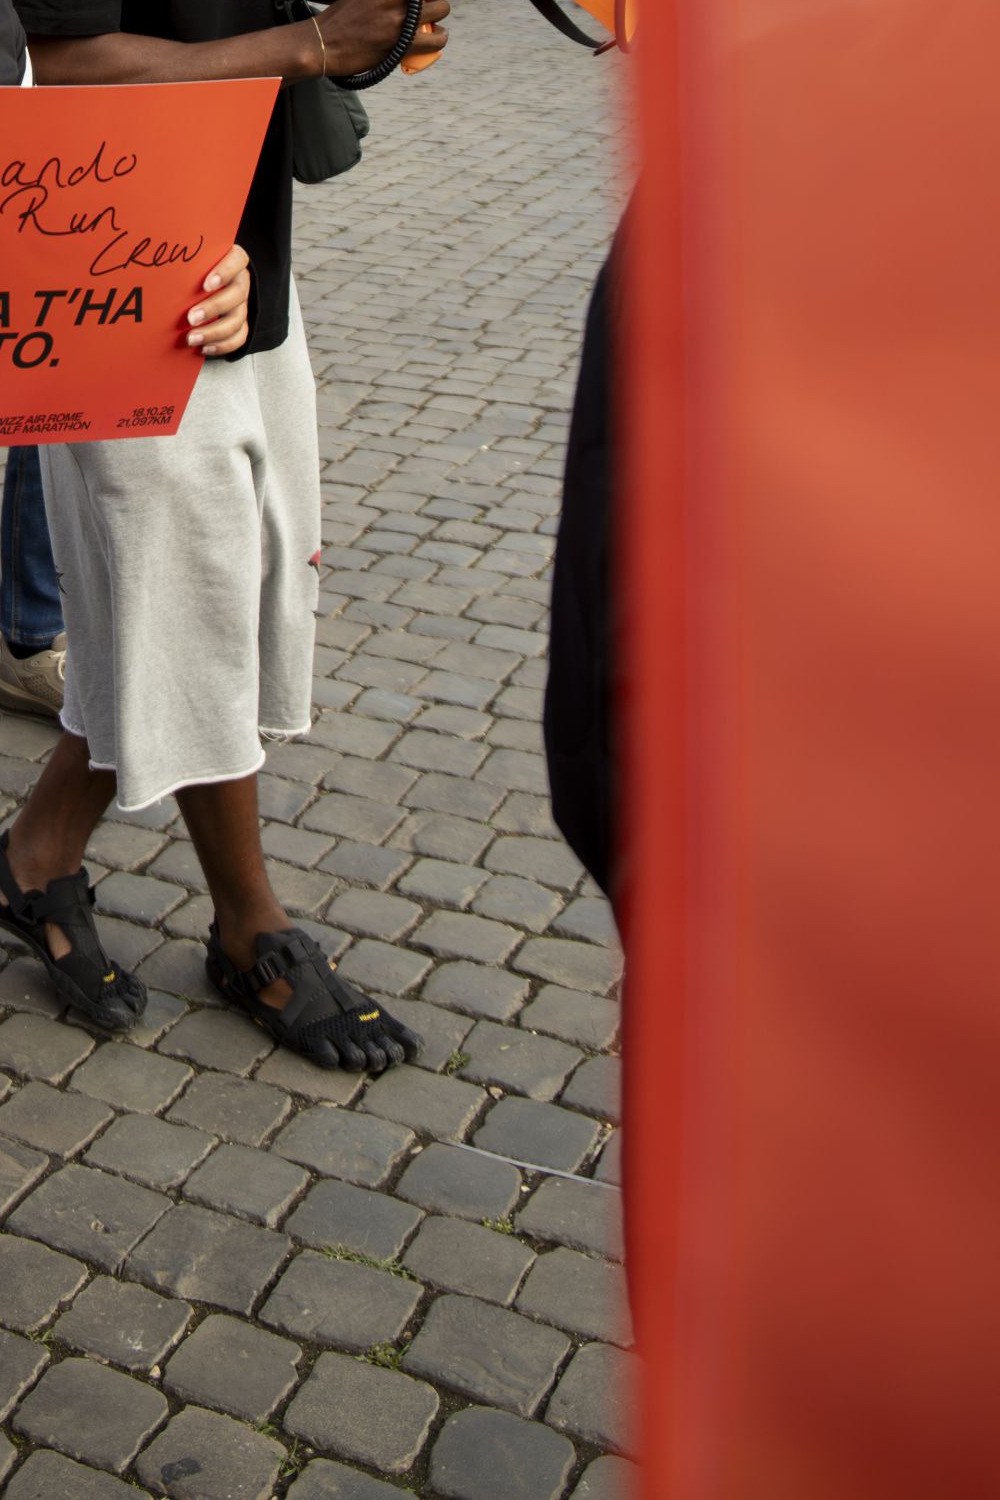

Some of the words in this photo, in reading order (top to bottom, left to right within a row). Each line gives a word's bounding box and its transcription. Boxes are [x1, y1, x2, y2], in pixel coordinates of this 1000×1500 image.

[0, 186, 121, 235] Run
[25, 414, 48, 423] AIR
[49, 412, 84, 421] ROME
[132, 406, 174, 417] 18.10.26
[22, 421, 91, 434] MARATHON
